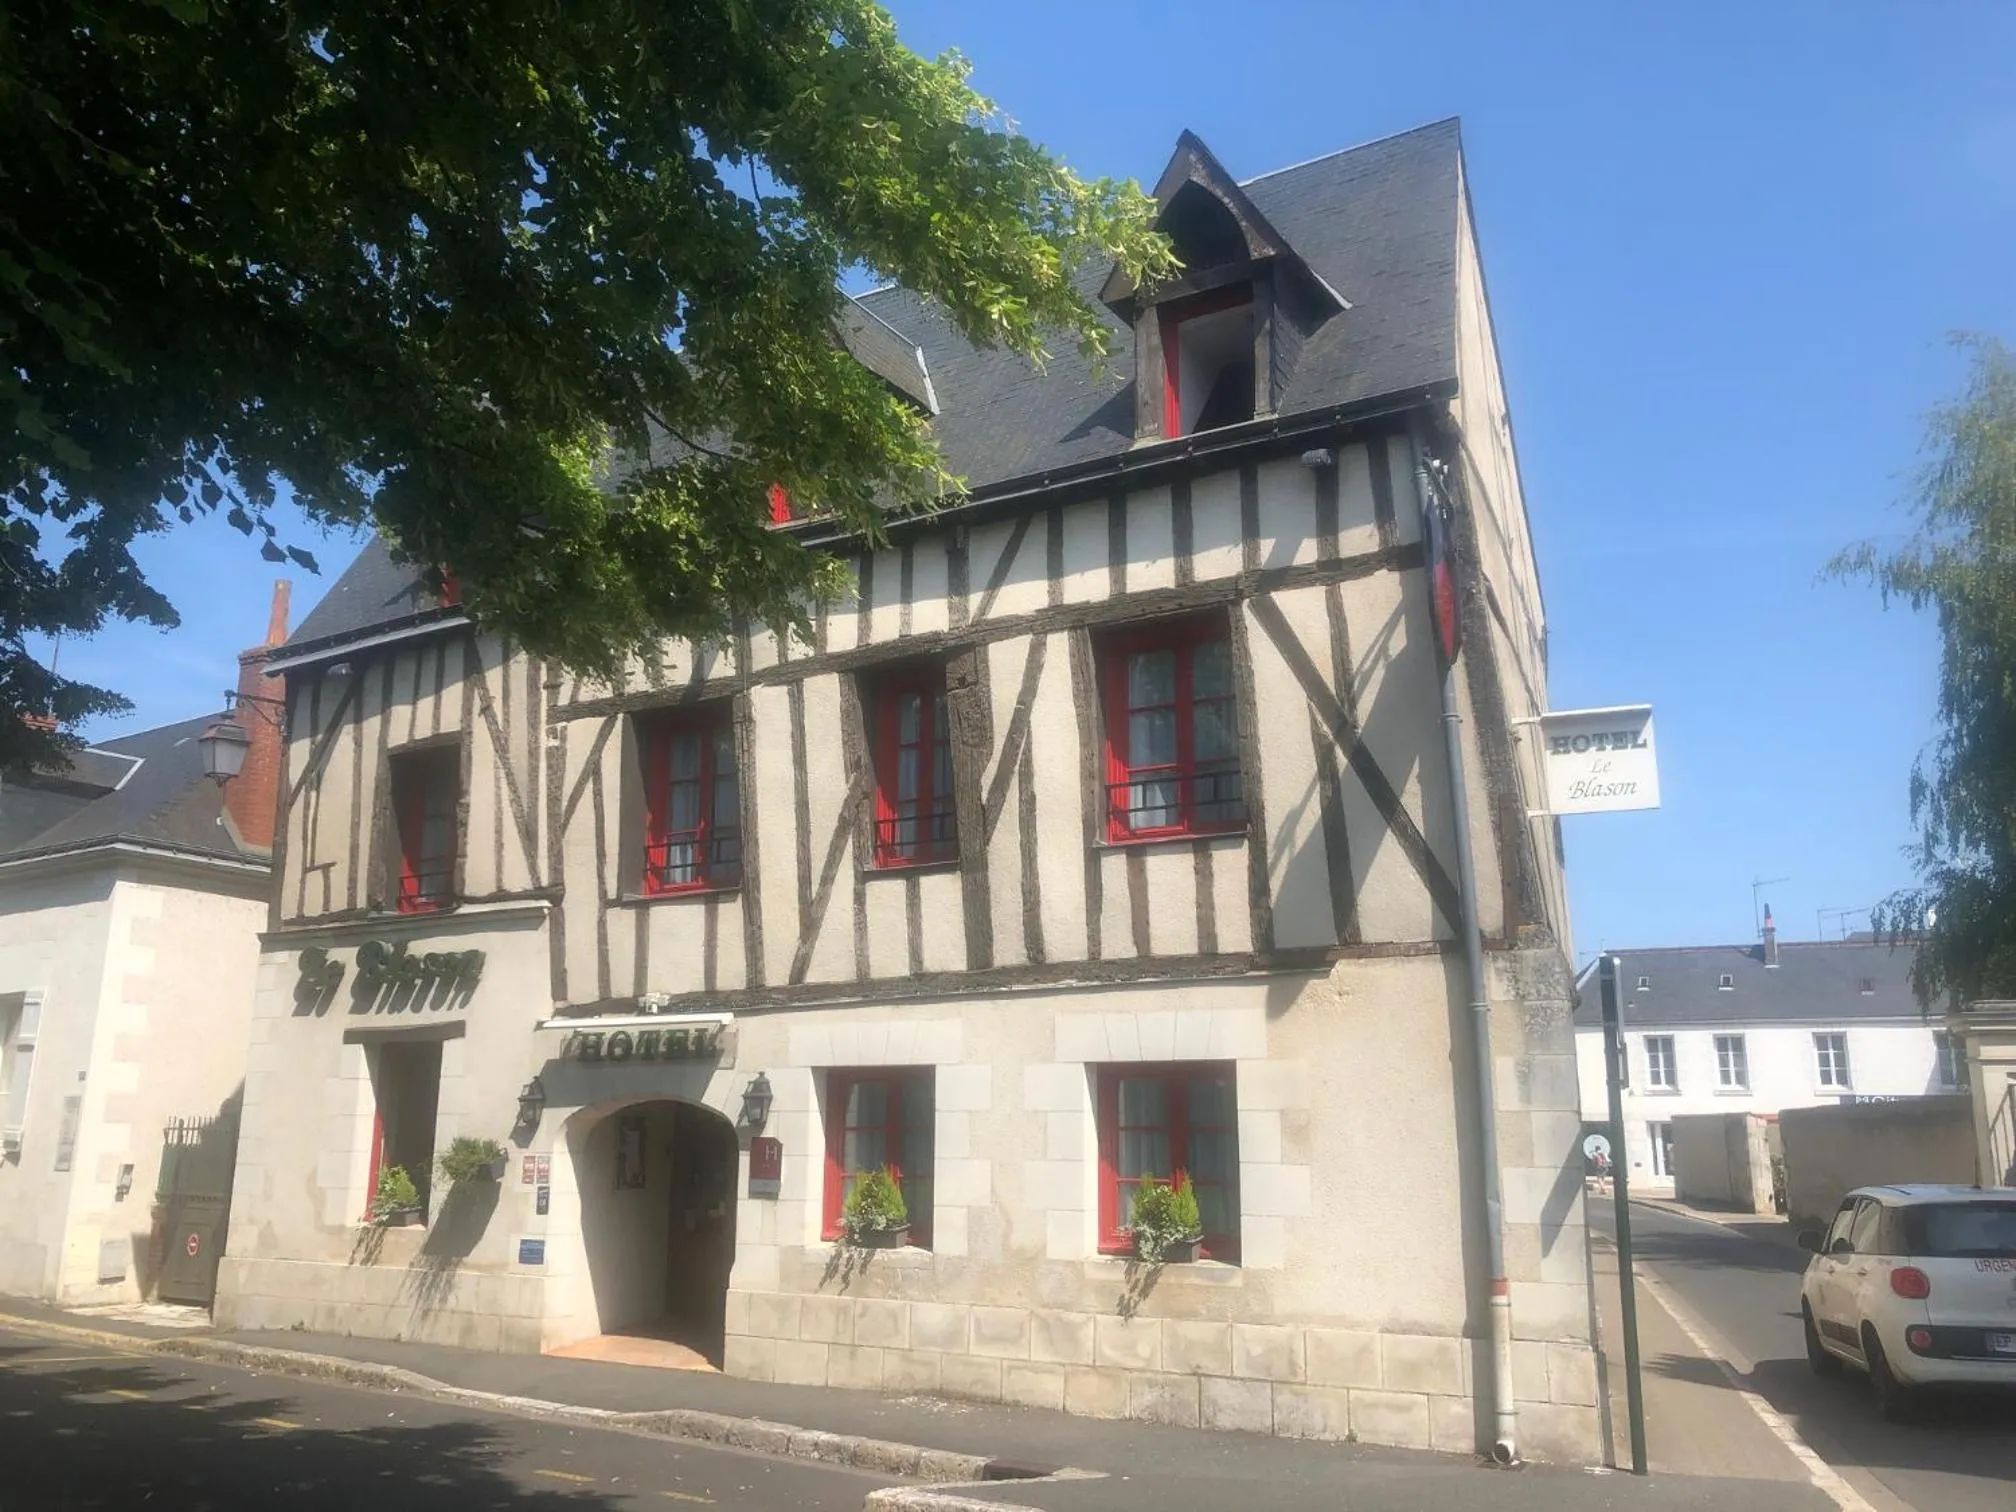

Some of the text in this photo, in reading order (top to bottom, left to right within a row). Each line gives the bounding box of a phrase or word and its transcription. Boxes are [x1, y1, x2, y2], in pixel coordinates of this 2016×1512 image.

[1549, 730, 1648, 756] HOTEL
[1590, 759, 1612, 774] Le
[1568, 777, 1639, 799] Blason
[574, 1028, 717, 1062] HOTEL
